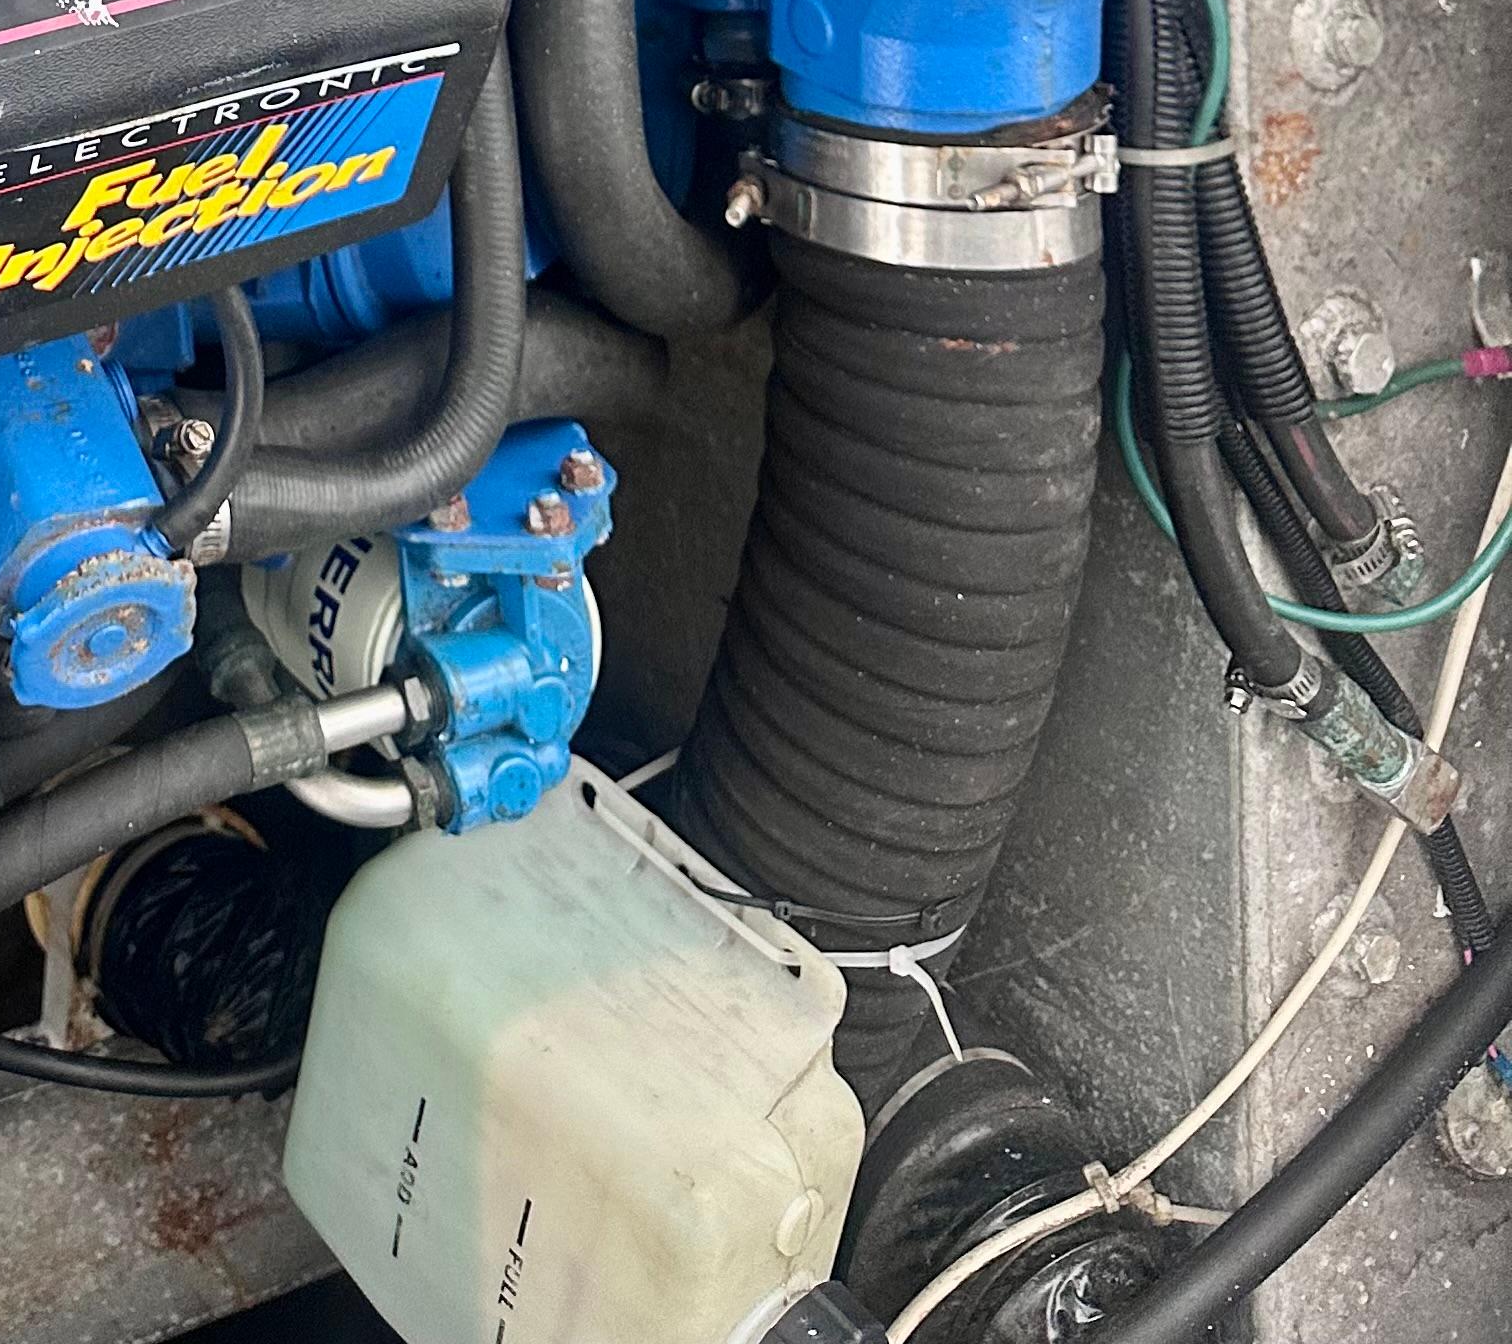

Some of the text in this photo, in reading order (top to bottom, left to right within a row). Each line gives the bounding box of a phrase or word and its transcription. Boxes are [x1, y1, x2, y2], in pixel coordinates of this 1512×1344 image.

[60, 123, 287, 232] Fuel
[396, 1145, 419, 1205] ADD
[497, 1247, 524, 1311] FULL
